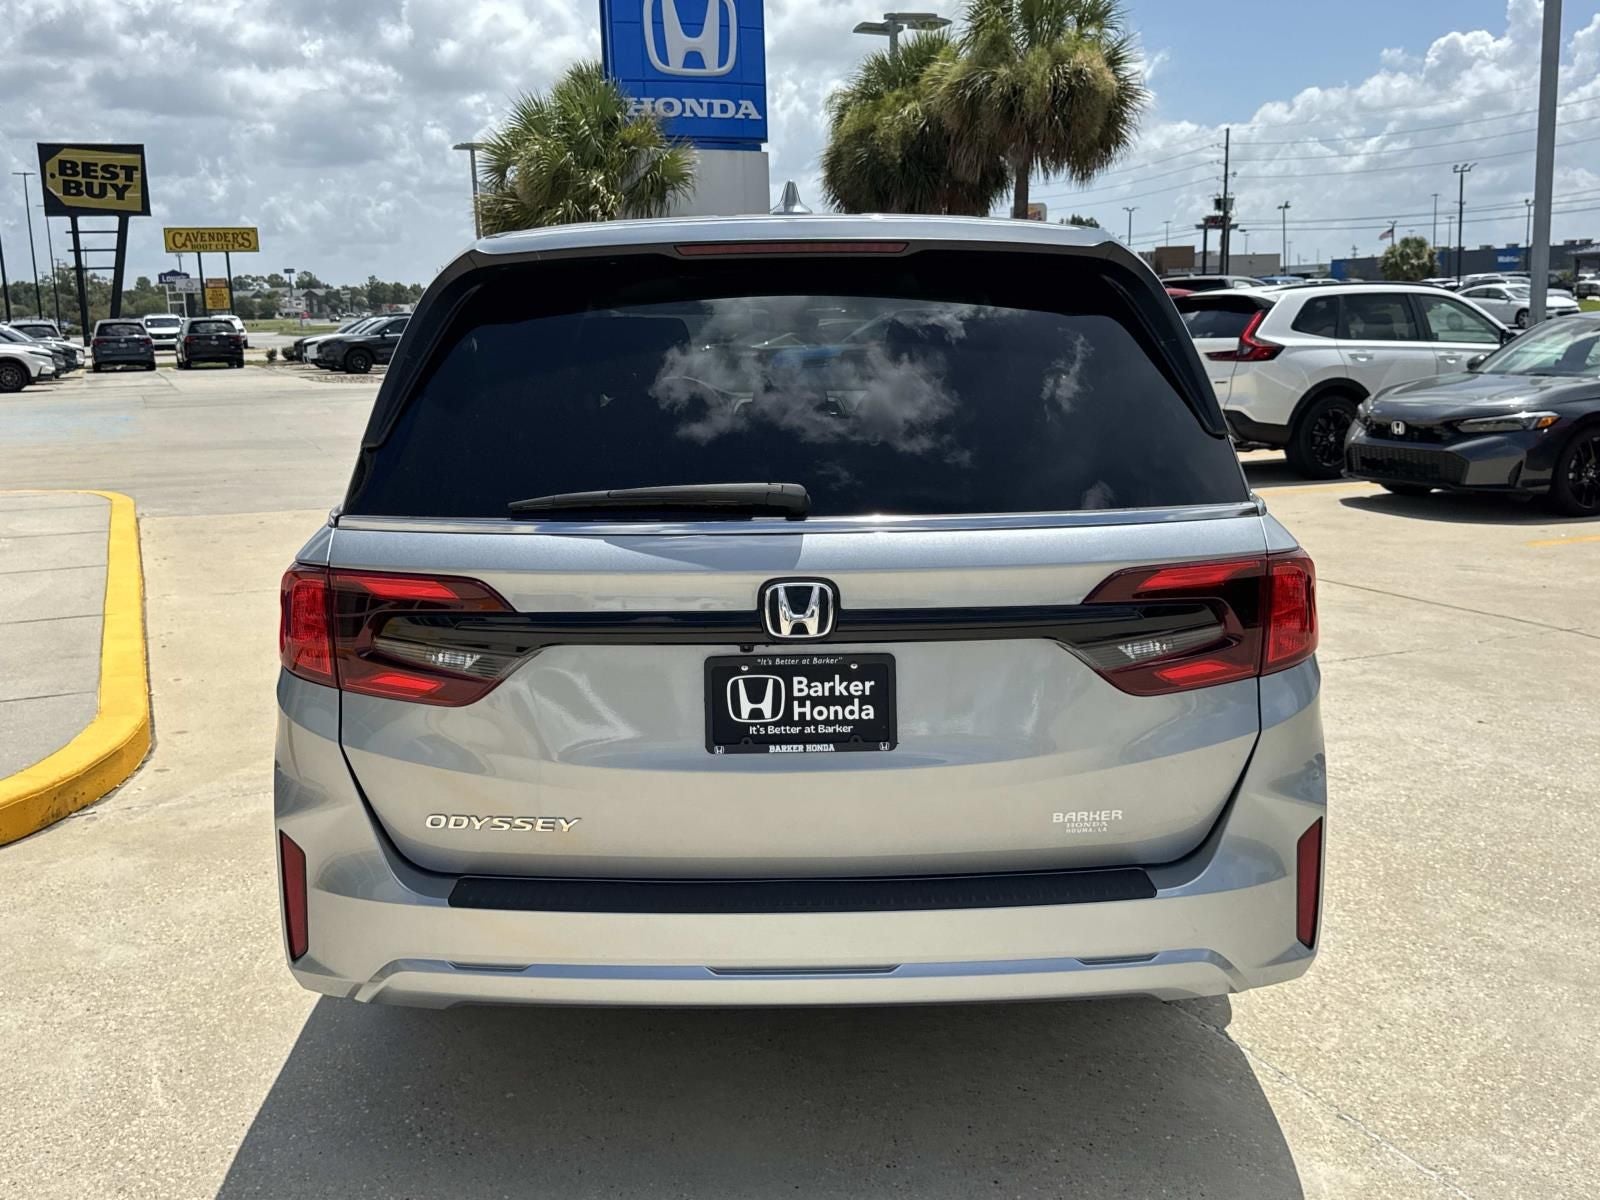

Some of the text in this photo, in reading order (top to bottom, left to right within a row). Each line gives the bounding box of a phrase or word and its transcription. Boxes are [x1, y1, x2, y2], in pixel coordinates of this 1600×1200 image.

[624, 97, 763, 120] HONDA
[58, 159, 139, 183] BEST
[62, 179, 132, 201] BUY
[172, 231, 252, 249] CAVENDER'S
[775, 657, 800, 666] Better
[792, 674, 875, 697] Barker
[792, 698, 875, 721] Honda
[749, 723, 854, 735] It's Better at Barker
[768, 743, 835, 753] BARKER HONDA
[425, 813, 582, 833] ODYSSEY
[1052, 810, 1123, 823] BARKER
